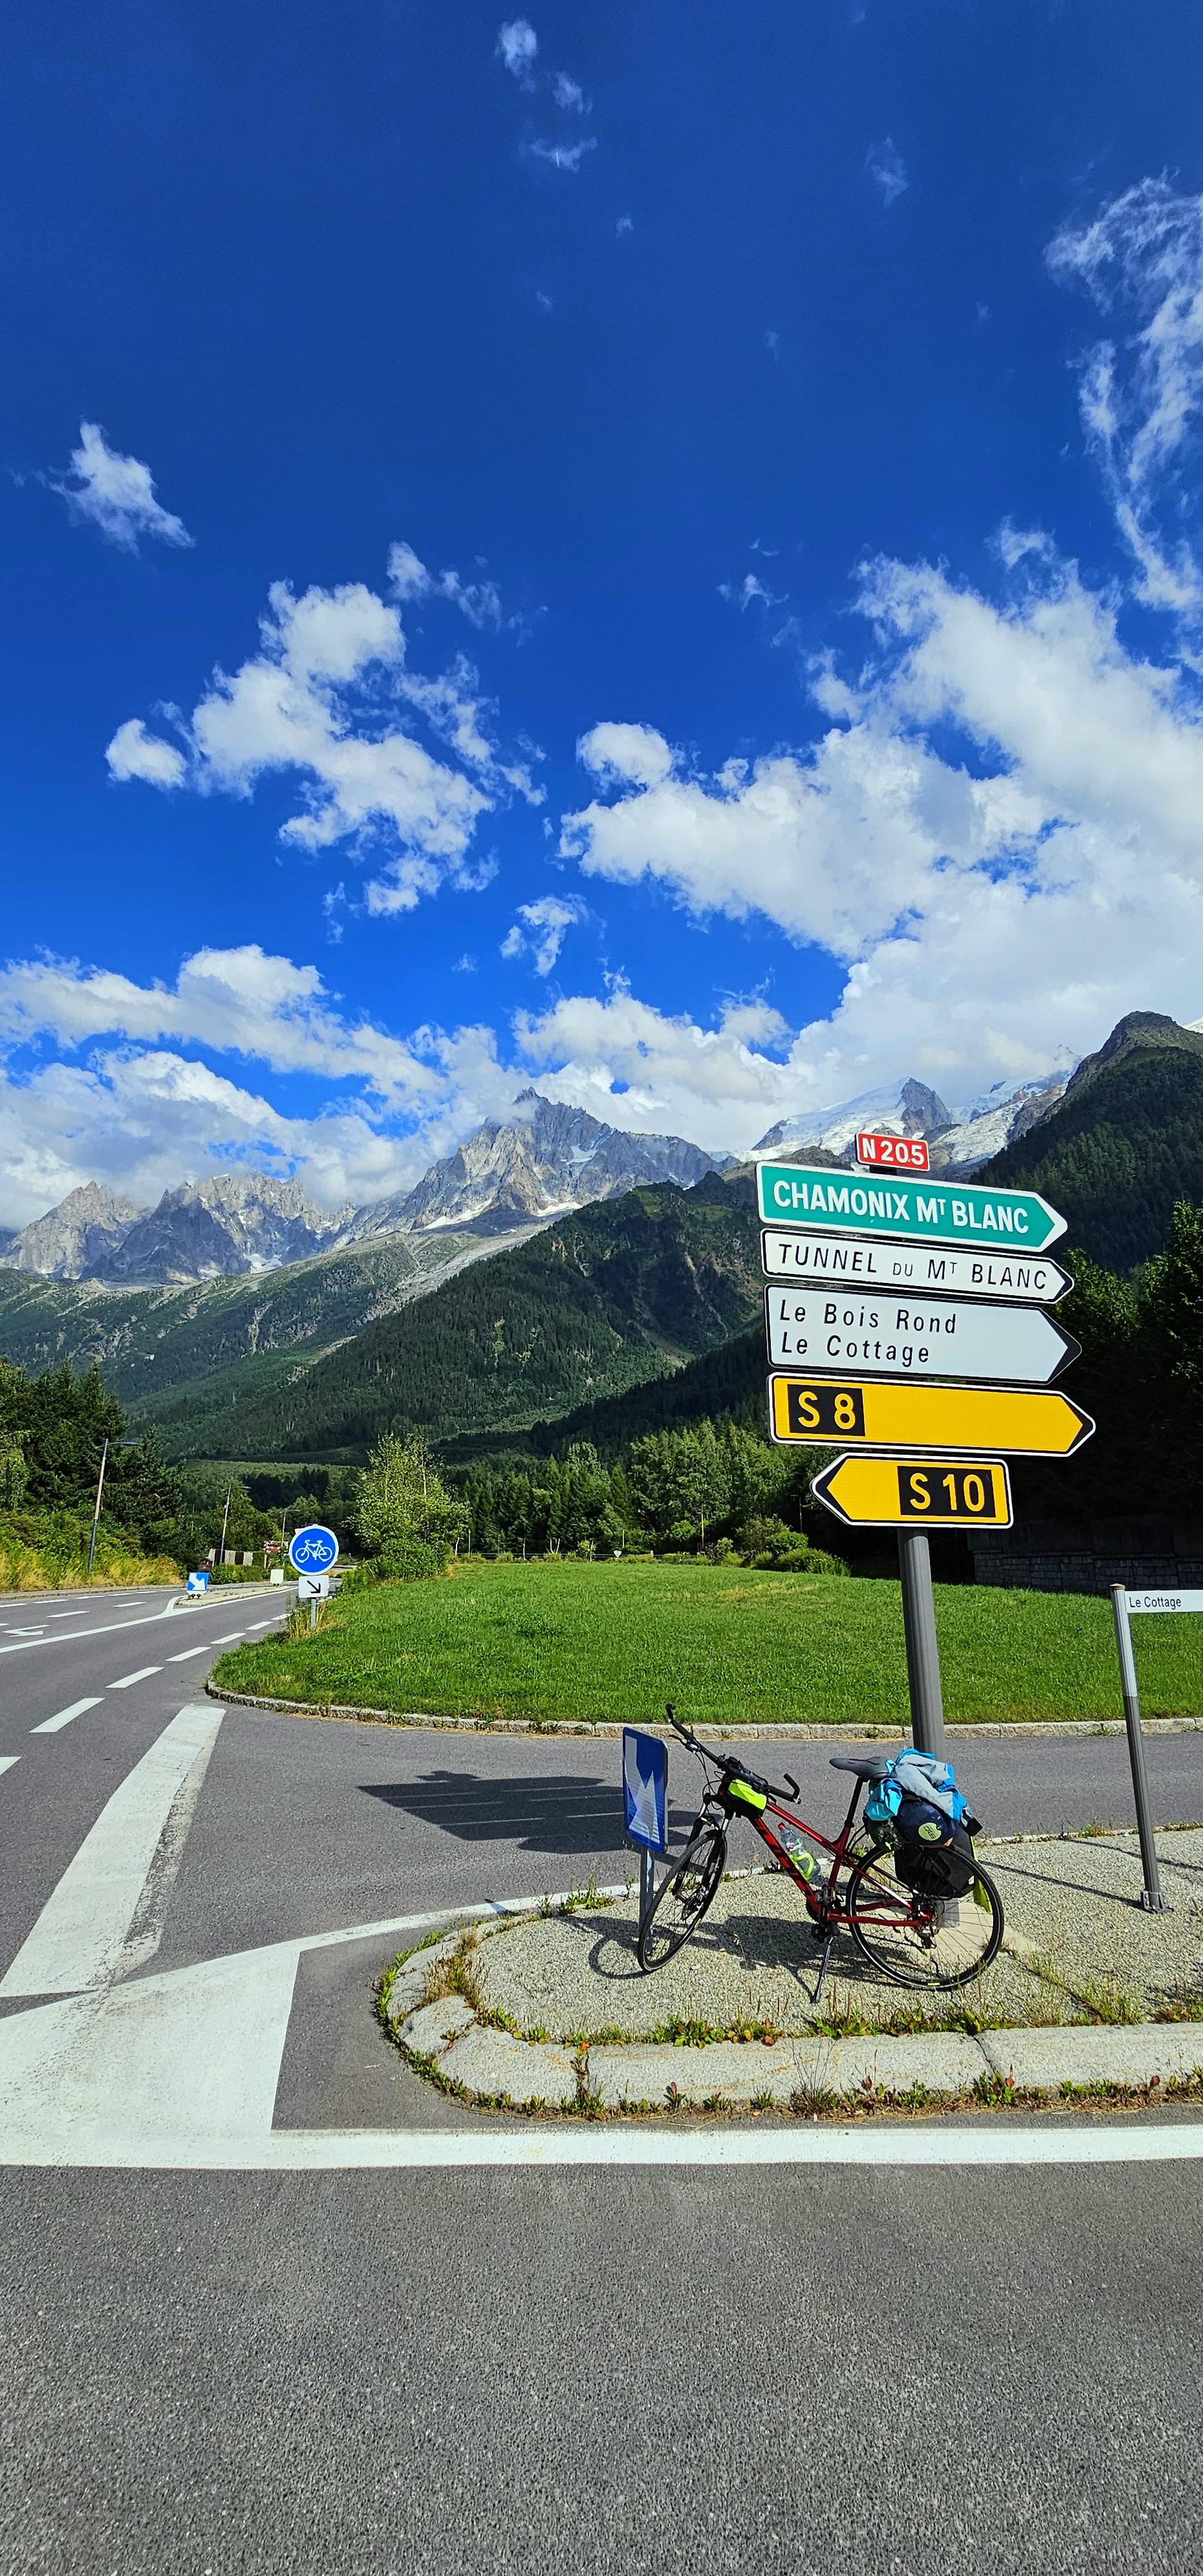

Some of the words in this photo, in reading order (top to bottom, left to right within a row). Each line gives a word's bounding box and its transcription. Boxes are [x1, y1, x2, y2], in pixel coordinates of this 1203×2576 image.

[862, 1137, 876, 1159] N
[880, 1140, 925, 1166] 205
[773, 1180, 910, 1220] CHAMONIX
[951, 1200, 1028, 1234] BLANC
[779, 1244, 877, 1273] TUNNEL
[893, 1262, 913, 1277] DU
[971, 1264, 1047, 1290] BLANC
[779, 1299, 806, 1322] Le
[824, 1303, 878, 1328] Bois
[896, 1309, 956, 1334] Rond
[781, 1331, 808, 1354] Le
[826, 1334, 929, 1368] Cottage
[797, 1391, 820, 1428] S
[834, 1393, 856, 1430] 8
[909, 1472, 931, 1510] S
[942, 1473, 985, 1512] 10
[1128, 1596, 1141, 1608] Le
[1144, 1596, 1182, 1610] Cottage
